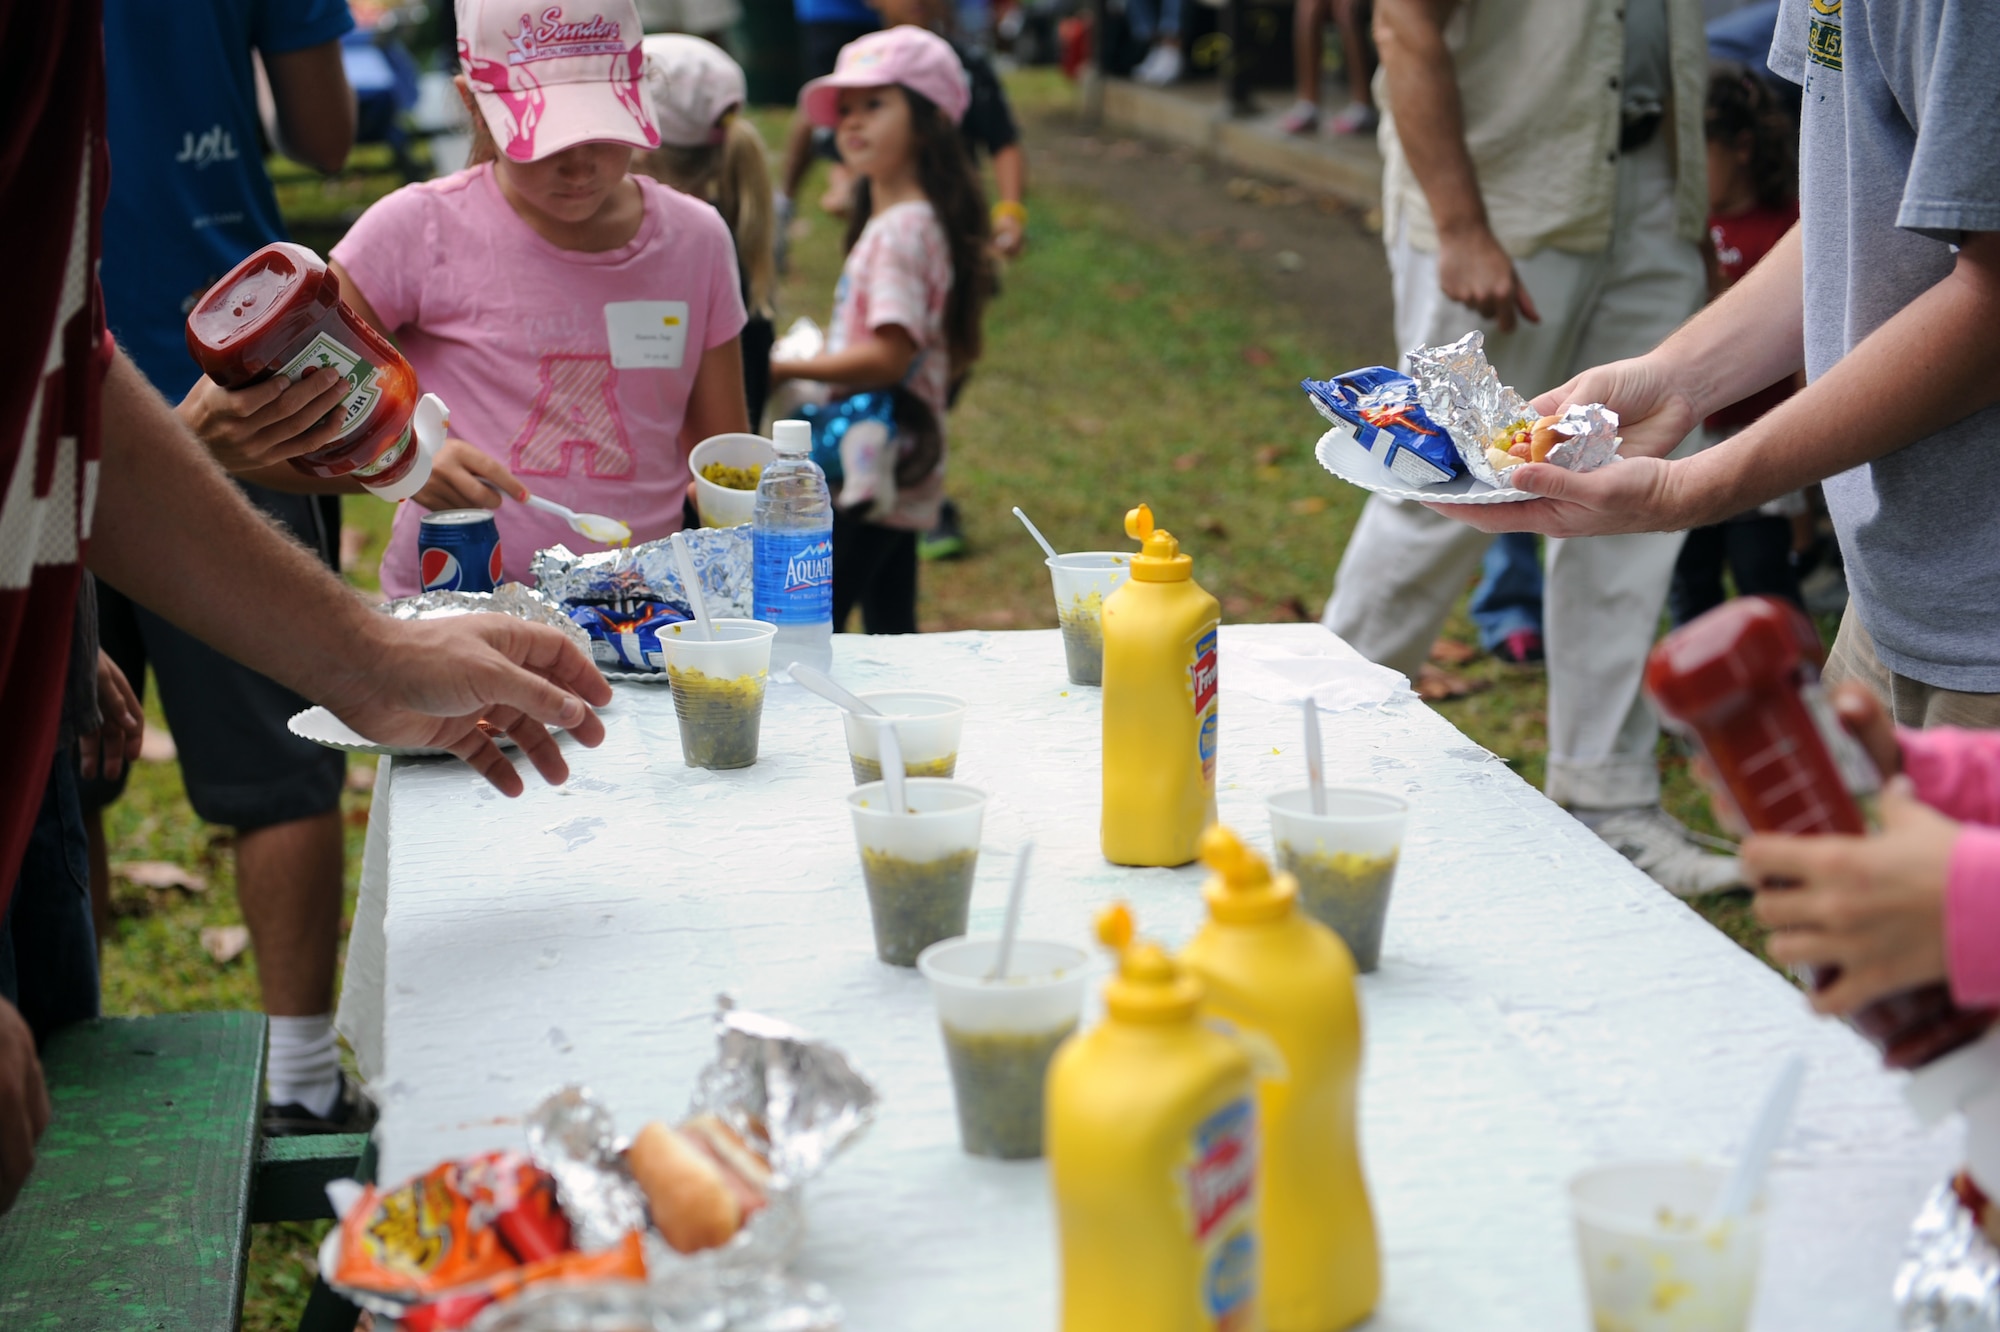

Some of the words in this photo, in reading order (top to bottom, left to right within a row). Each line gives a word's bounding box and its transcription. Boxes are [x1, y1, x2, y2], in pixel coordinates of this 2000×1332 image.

[536, 7, 619, 41] Sanders
[1811, 27, 1842, 54] BLIS
[784, 556, 832, 590] AQUAFI
